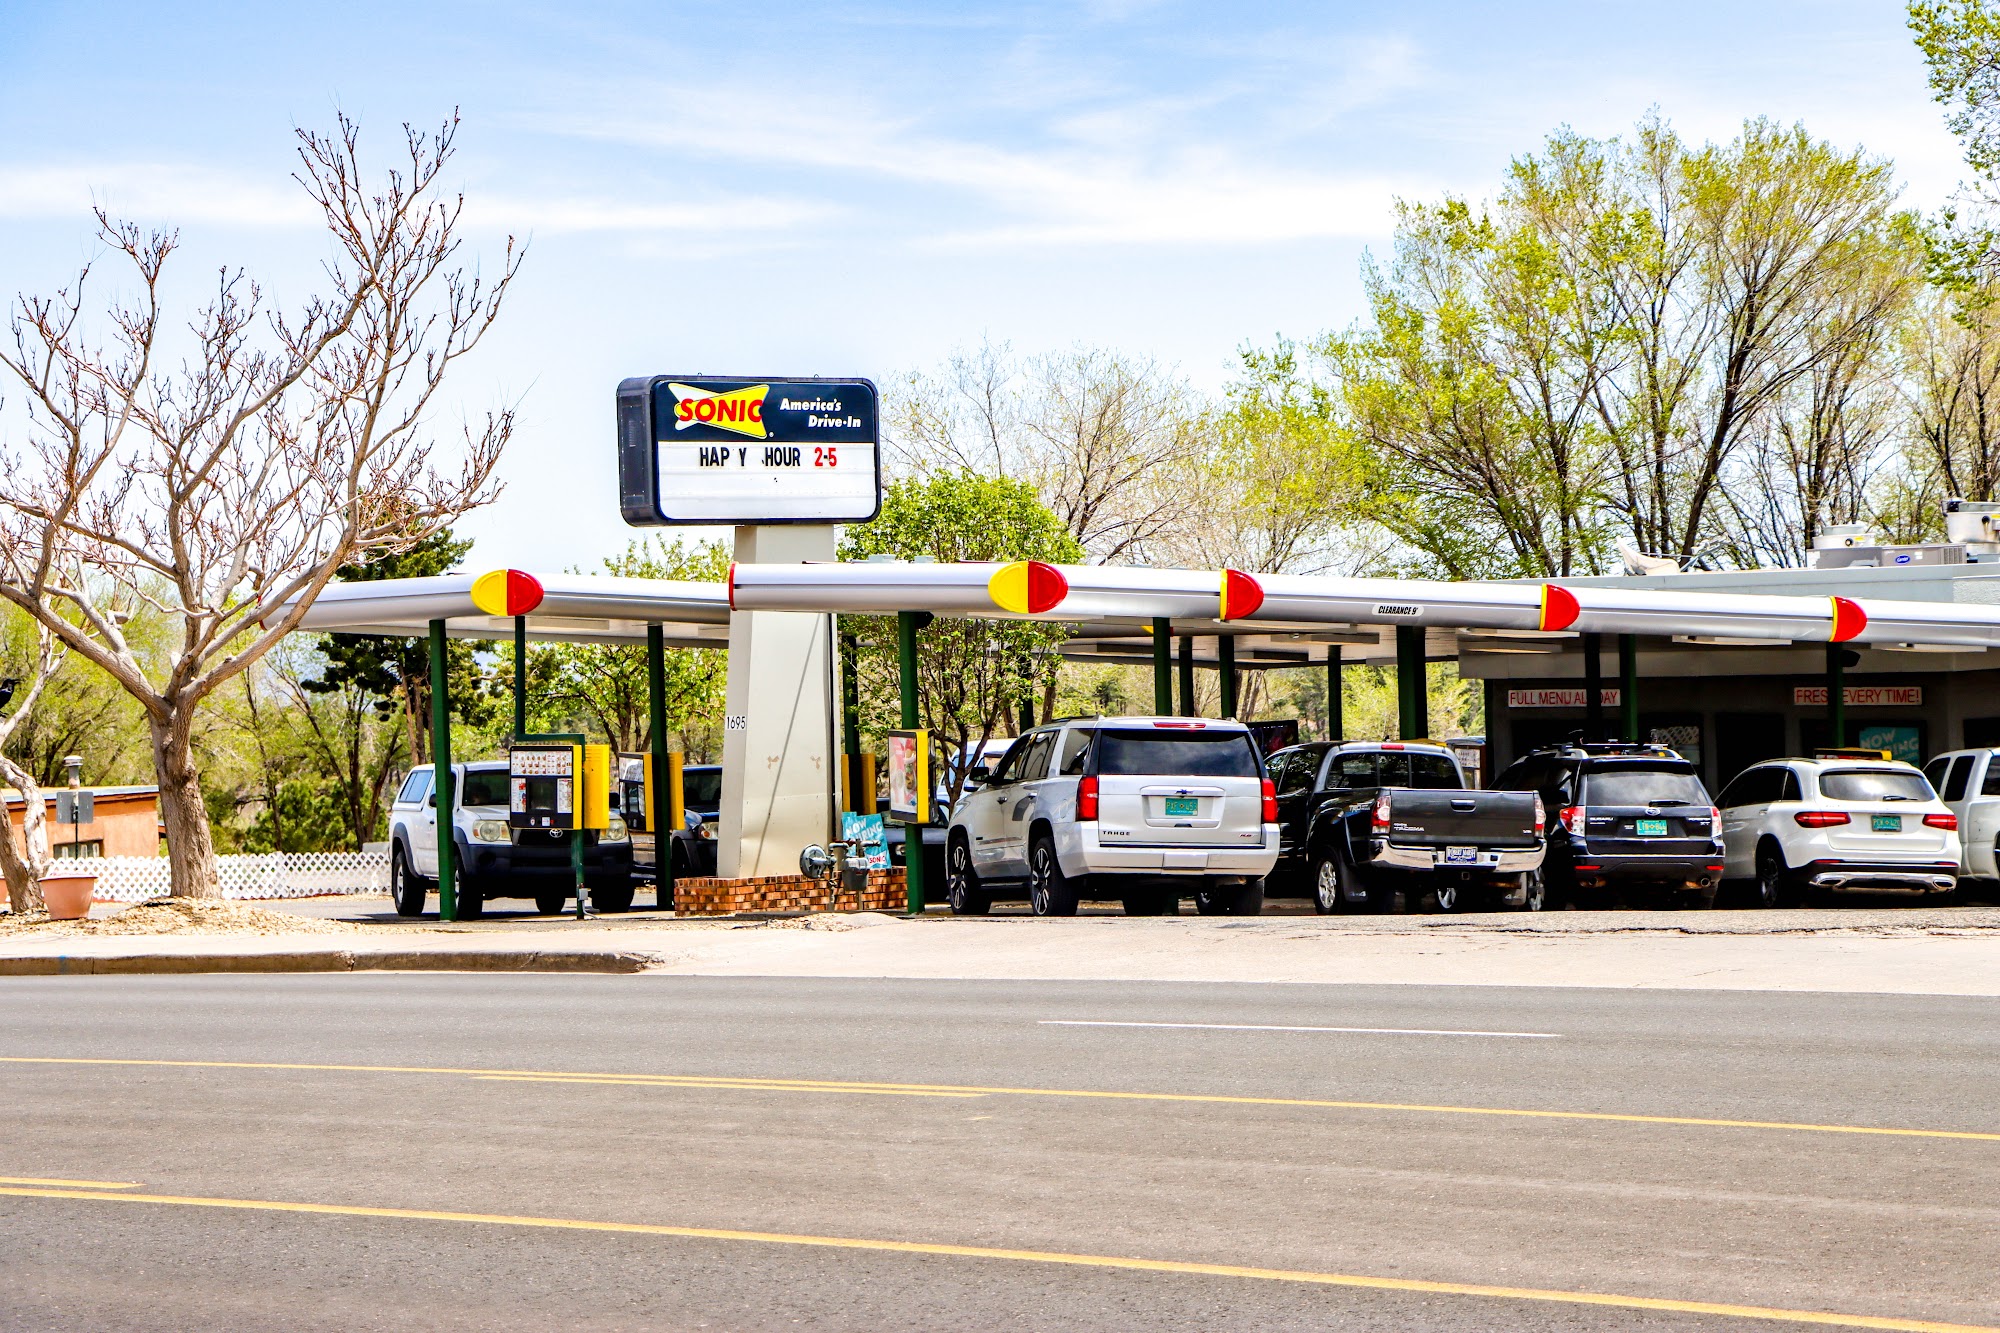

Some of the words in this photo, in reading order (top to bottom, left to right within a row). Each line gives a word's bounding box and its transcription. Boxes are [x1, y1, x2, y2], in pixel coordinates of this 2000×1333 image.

[678, 398, 763, 422] SONIC
[780, 398, 842, 412] America's
[764, 447, 801, 467] HOUR
[814, 447, 838, 467] 2-5
[1378, 605, 1410, 614] CLEARANCE
[1510, 692, 1536, 704] FULL
[1539, 692, 1571, 704] MENU
[1796, 689, 1829, 703] FRES
[1842, 689, 1881, 703] EVERY
[1884, 689, 1920, 703] TIME!
[727, 716, 746, 729] 1695
[1861, 729, 1896, 747] NOW
[845, 818, 867, 837] NOW
